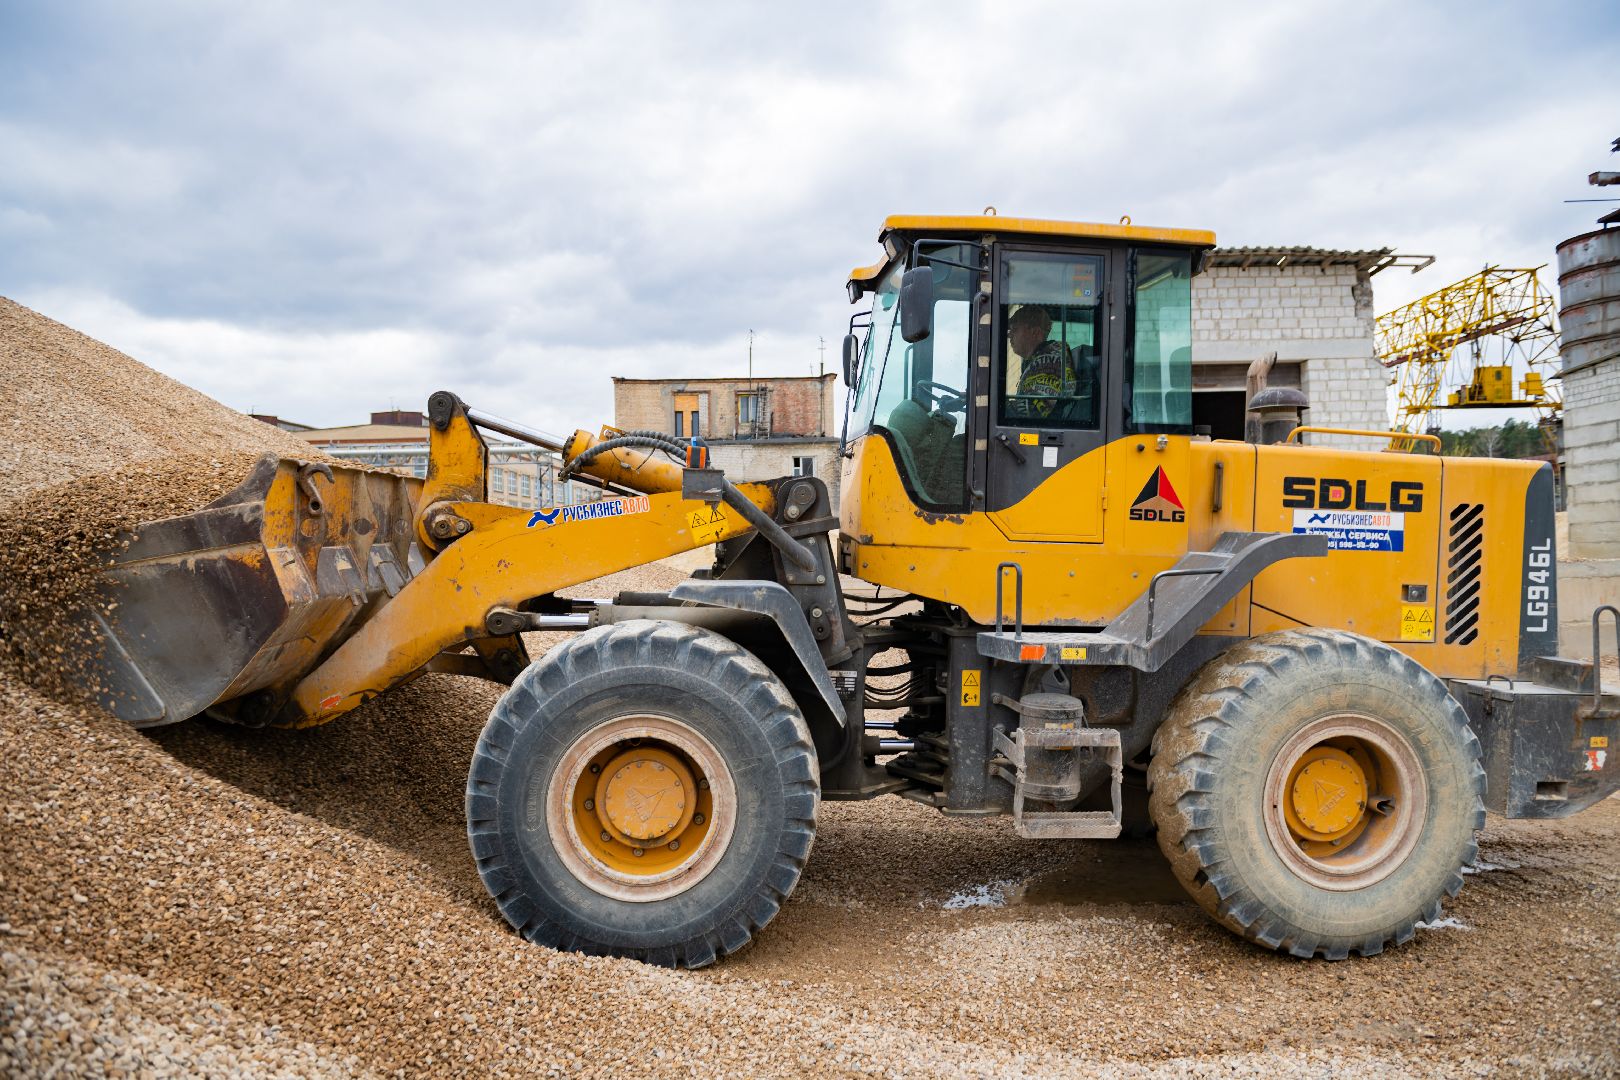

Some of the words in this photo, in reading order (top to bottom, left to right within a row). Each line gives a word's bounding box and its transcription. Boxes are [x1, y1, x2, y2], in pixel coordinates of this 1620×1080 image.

[1283, 477, 1423, 512] SDLG
[563, 497, 649, 522] РУСБИЗНЕСАВТО
[1129, 509, 1185, 522] SDLG
[1332, 513, 1391, 527] РУСБИЗНЕСАВТО
[1348, 531, 1390, 541] СЕРВИСА
[1526, 537, 1551, 632] LG946L
